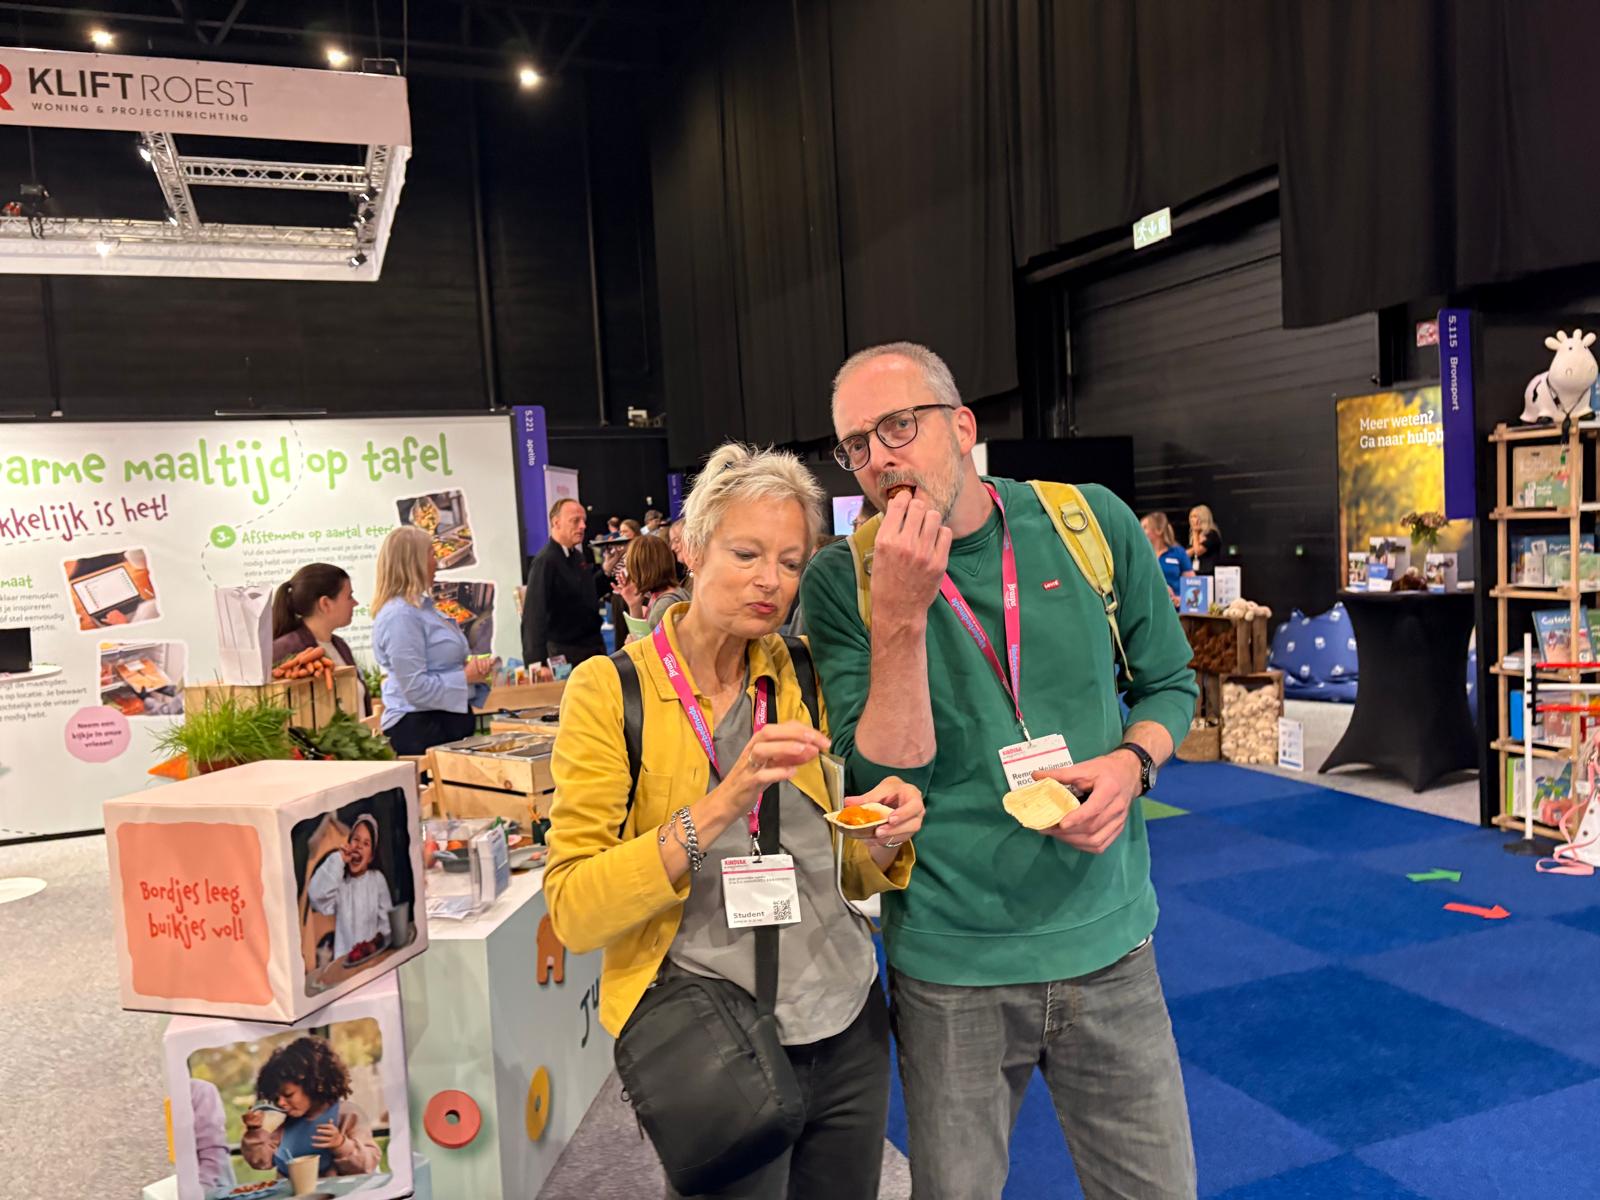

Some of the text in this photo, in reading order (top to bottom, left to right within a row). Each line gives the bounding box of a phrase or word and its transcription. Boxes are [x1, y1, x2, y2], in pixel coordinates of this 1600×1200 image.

[32, 102, 249, 122] WONING & PROJECTINRICHTING
[1450, 356, 1459, 411] Bronsport
[1360, 410, 1434, 431] Meer weten?
[1360, 435, 1376, 448] Ga
[1377, 434, 1405, 447] naar
[0, 432, 453, 505] arme maaltijd op tafel
[93, 501, 114, 527] is
[120, 494, 169, 522] het!
[241, 529, 305, 544] Afstemmen
[308, 530, 322, 543] op
[325, 524, 361, 539] aantal
[0, 574, 33, 588] maat
[1012, 770, 1032, 780] Rem
[139, 876, 246, 915] Bordjes leeg,
[733, 911, 766, 919] Student
[148, 912, 245, 949] buikjes vol!
